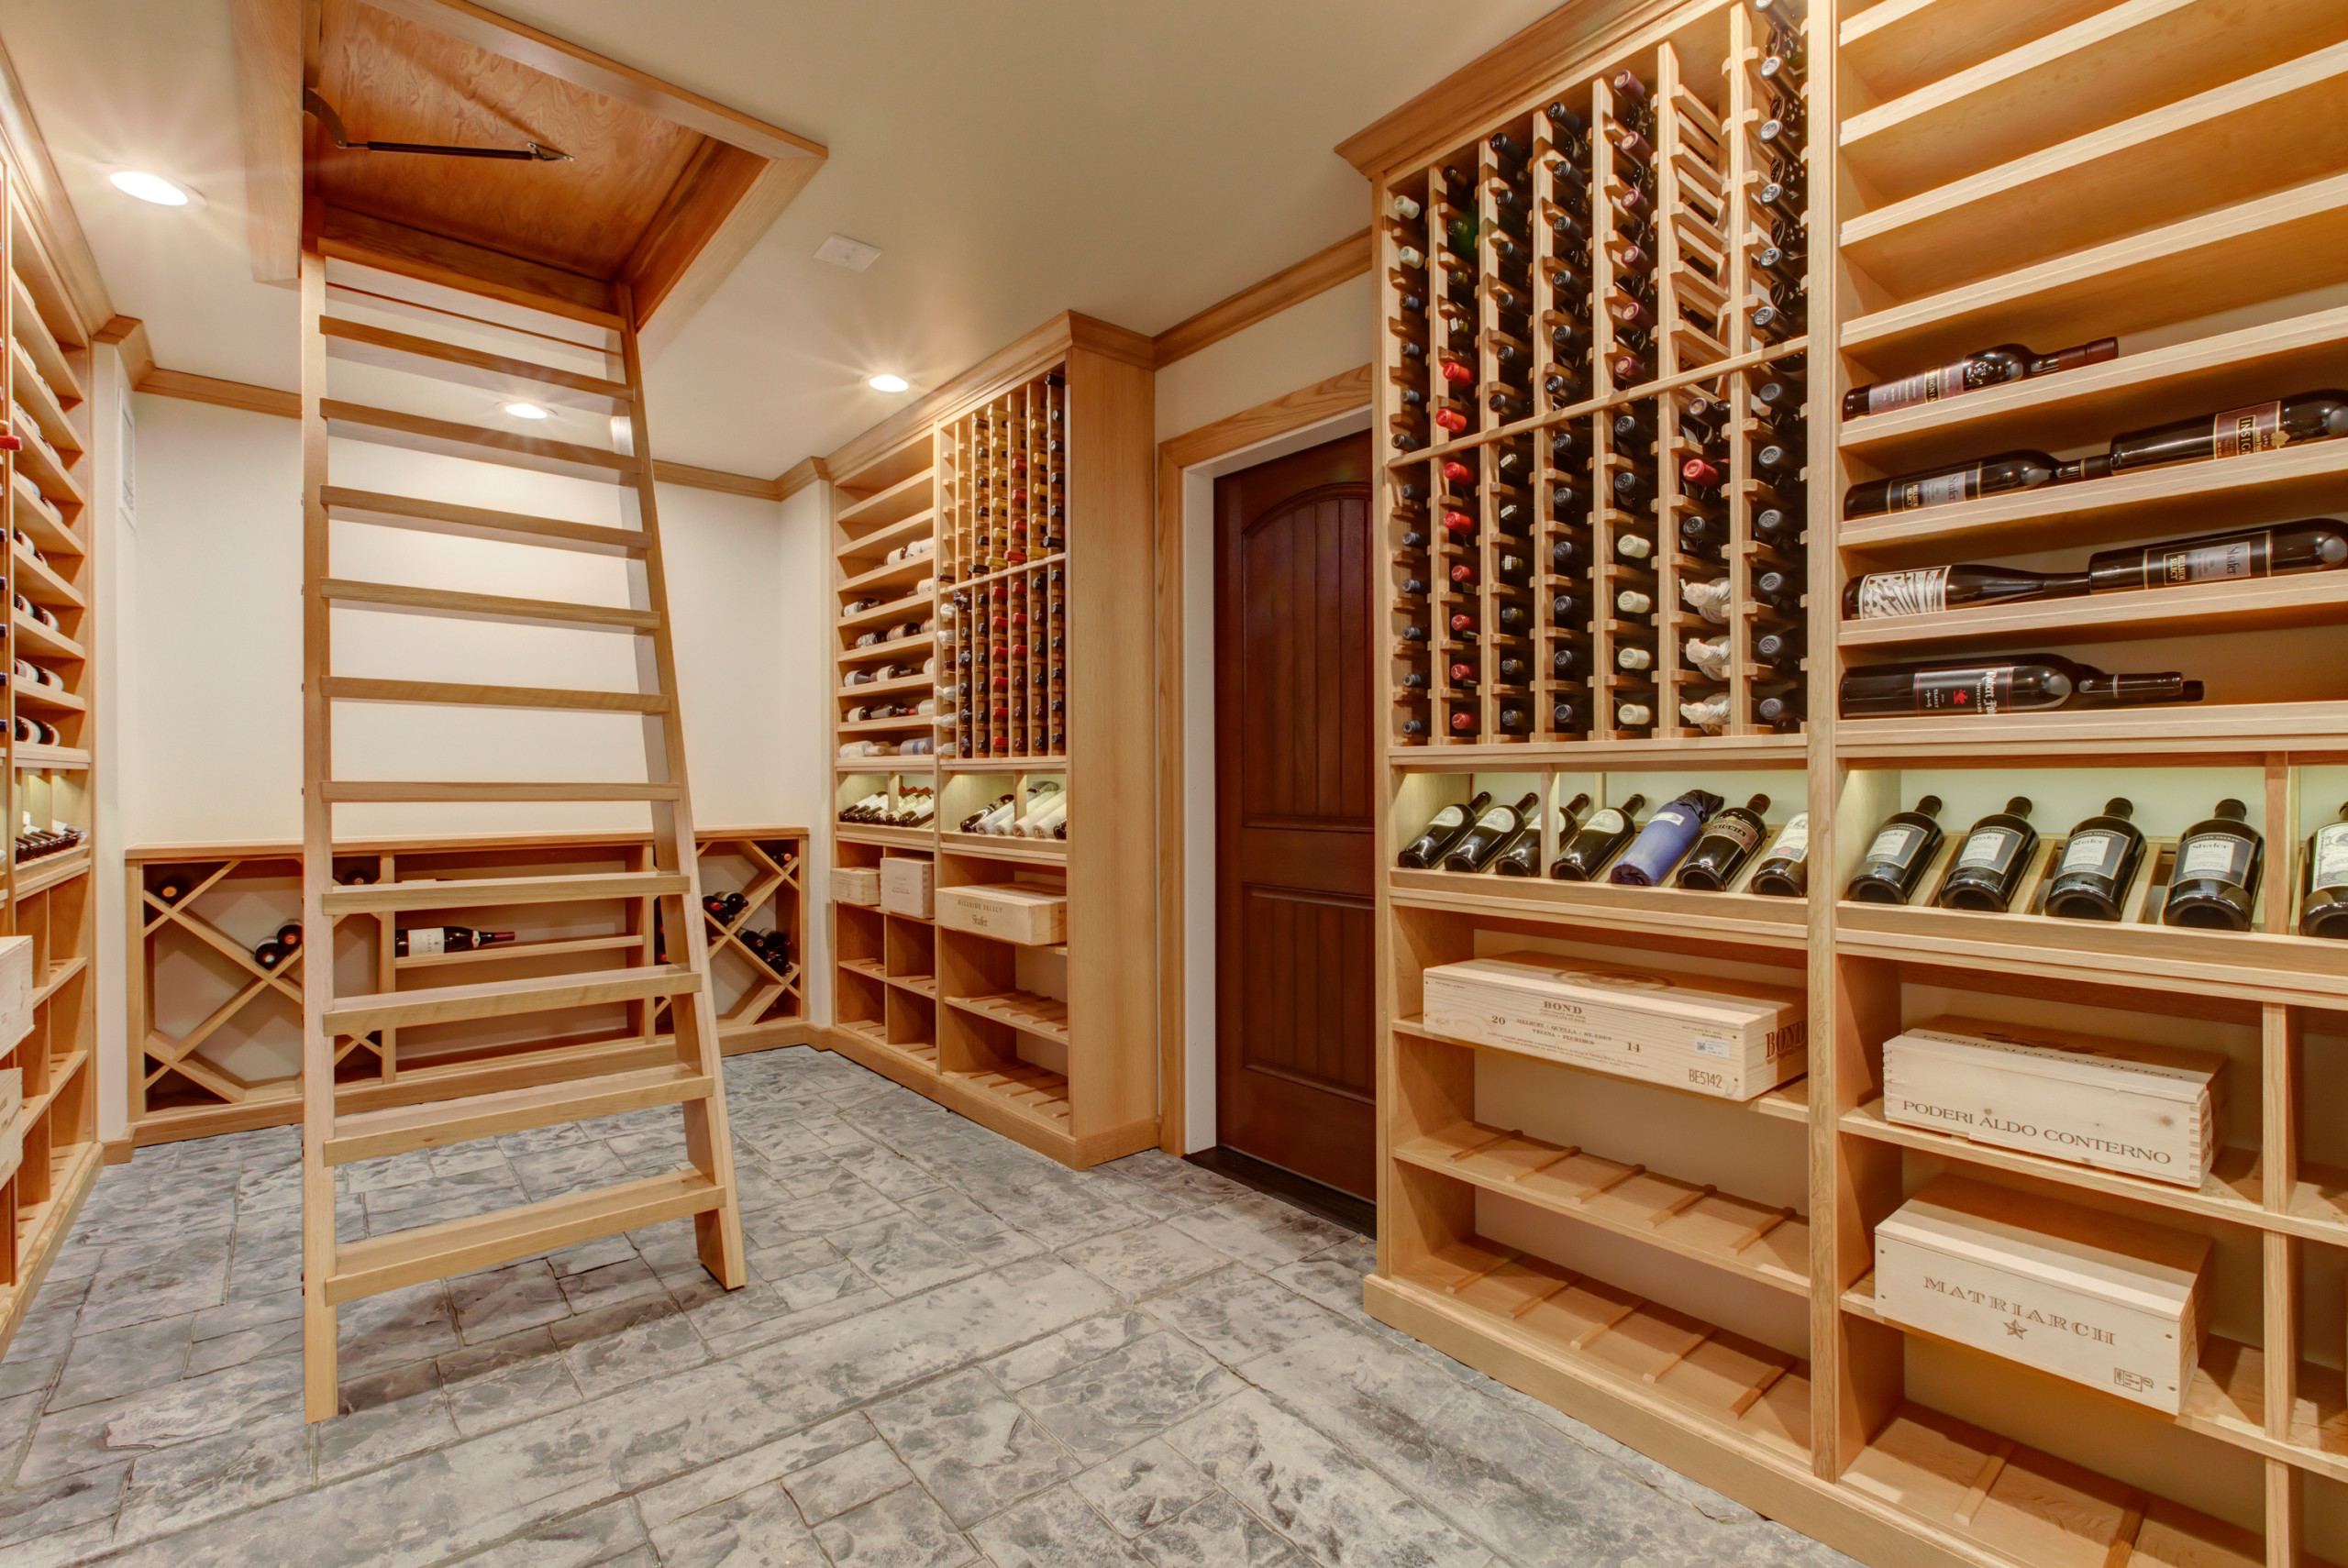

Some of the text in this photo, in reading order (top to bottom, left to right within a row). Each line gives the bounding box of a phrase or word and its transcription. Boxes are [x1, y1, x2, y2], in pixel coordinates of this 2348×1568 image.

[2226, 546, 2240, 575] Shafer
[1982, 669, 1997, 699] Robert
[958, 900, 1002, 913] HILLSIDE SELECT
[1544, 1001, 1583, 1015] BOND
[1491, 1015, 1506, 1025] 20
[1516, 1018, 1545, 1029] MELBURY
[1551, 1025, 1577, 1035] QUELLA
[1532, 1028, 1595, 1045] VECINA PLURIBUS
[1766, 1020, 1808, 1060] BOND
[1626, 1042, 1641, 1053] 14
[1689, 1068, 1722, 1089] BE5142
[1903, 1100, 1974, 1125] PODERI
[1978, 1117, 2038, 1137] ALDO
[2043, 1129, 2172, 1165] CONTERNO
[1922, 1276, 2117, 1346] MATRIARCH
